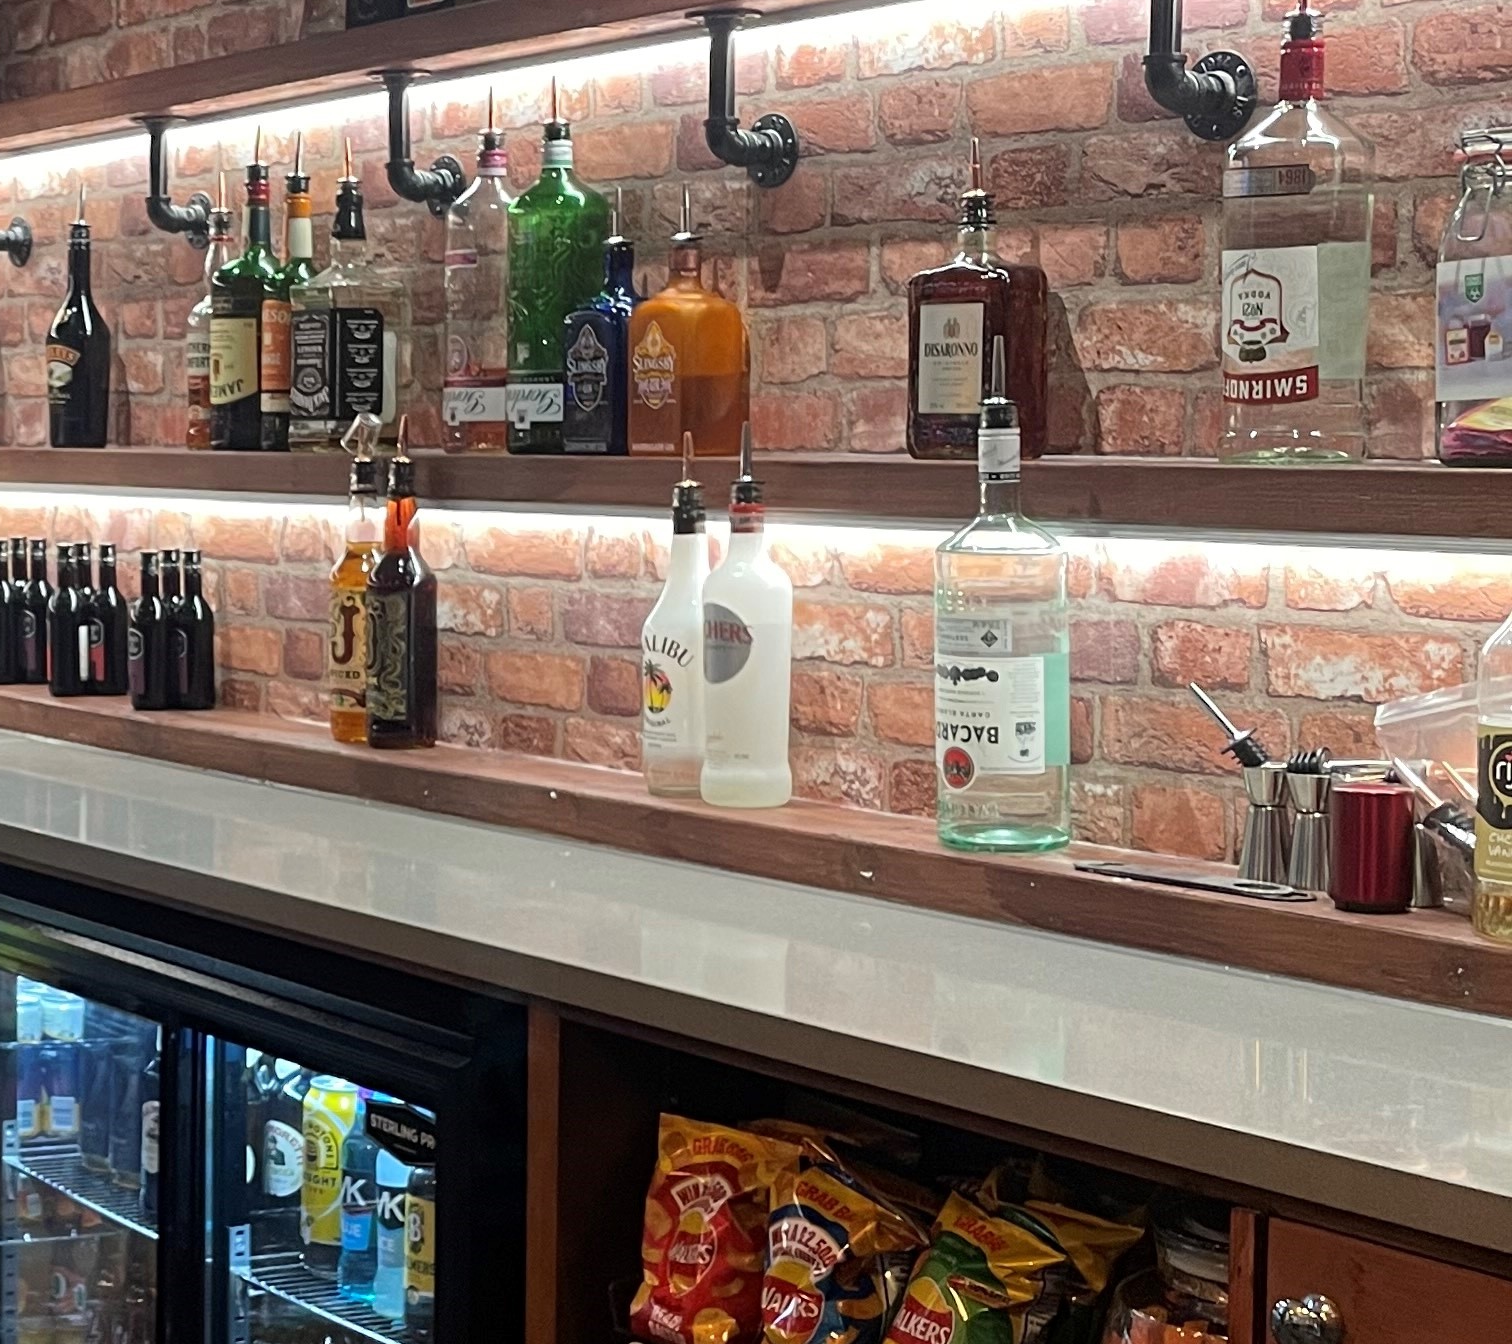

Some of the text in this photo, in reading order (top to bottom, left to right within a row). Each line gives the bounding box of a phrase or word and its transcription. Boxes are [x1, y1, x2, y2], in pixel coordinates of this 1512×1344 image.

[1237, 290, 1271, 300] VODKA
[923, 341, 980, 359] DISARONNO
[211, 378, 245, 399] JAME
[1224, 374, 1308, 400] SMIRNOF
[702, 616, 753, 644] CHERS
[644, 633, 696, 669] ALIBU
[936, 720, 1000, 745] BACARD
[369, 1112, 420, 1144] STERLING
[796, 1180, 858, 1225] GRAB BA
